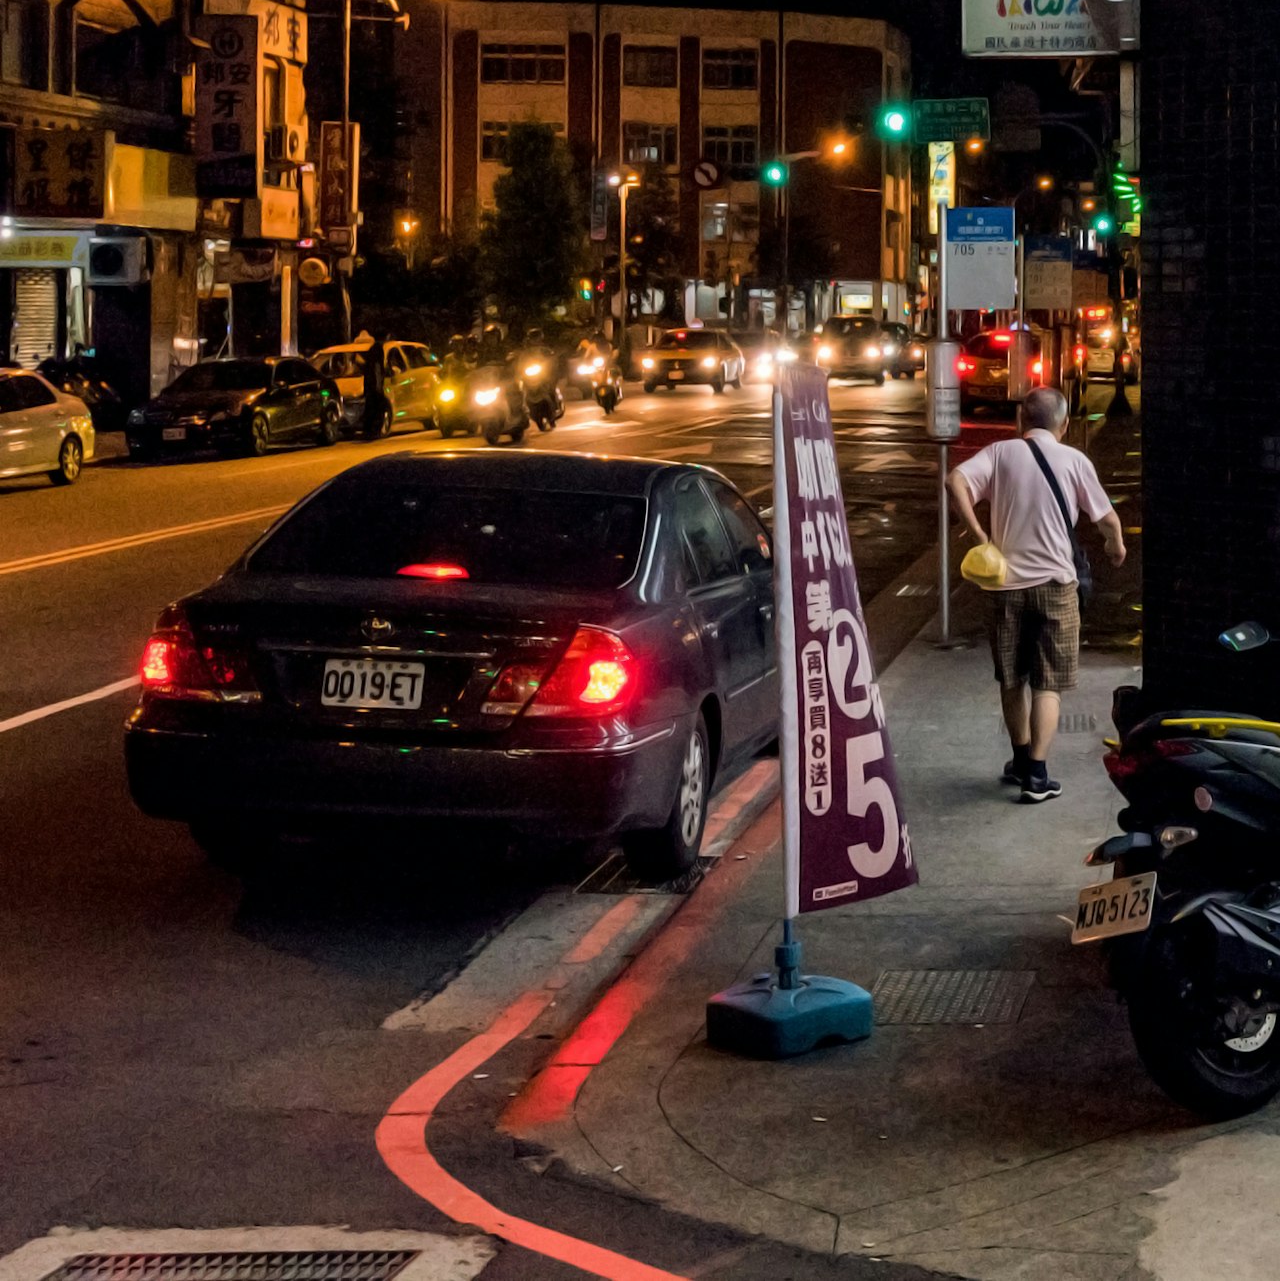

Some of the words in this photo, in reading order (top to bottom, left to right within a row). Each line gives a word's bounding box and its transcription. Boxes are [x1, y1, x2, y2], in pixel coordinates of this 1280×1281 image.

[1040, 20, 1060, 31] Your
[953, 243, 975, 256] 705
[806, 649, 829, 811] 再享買8送1
